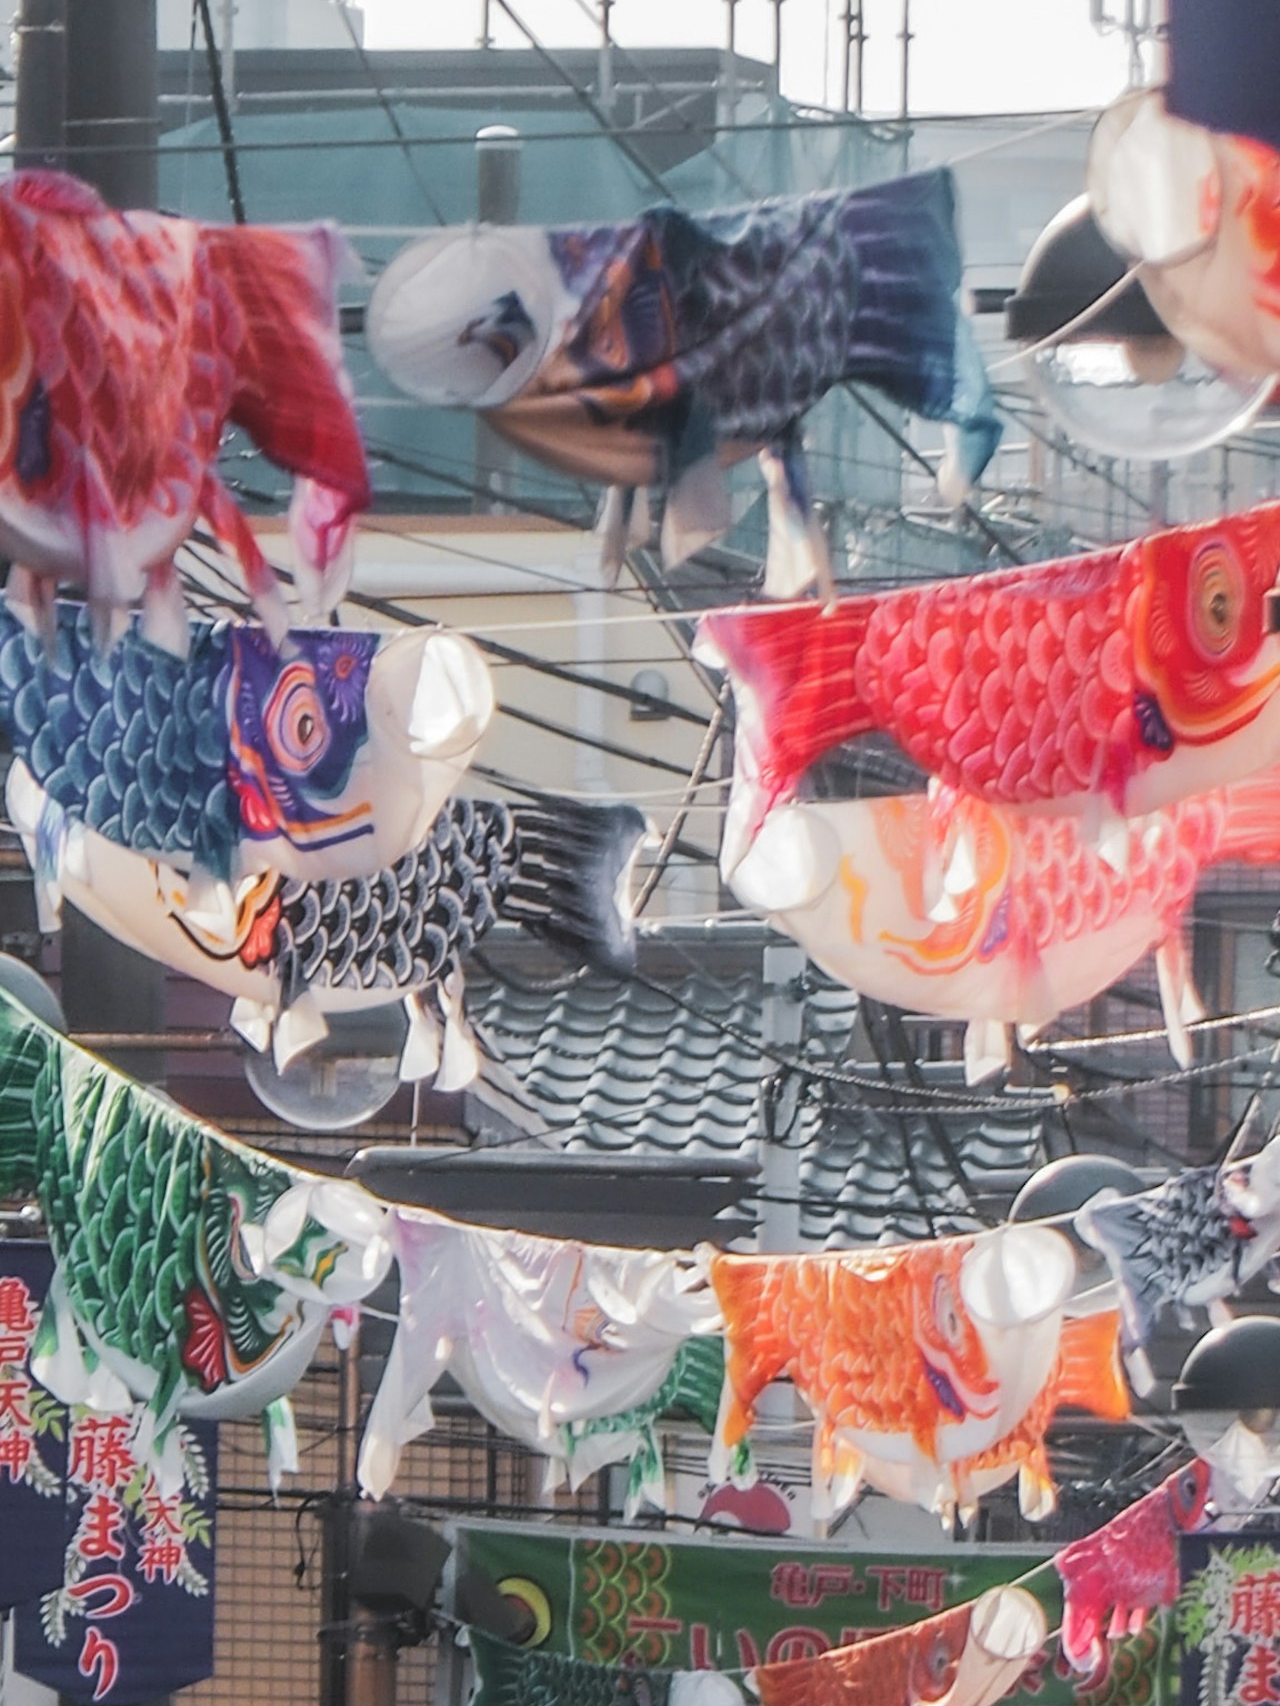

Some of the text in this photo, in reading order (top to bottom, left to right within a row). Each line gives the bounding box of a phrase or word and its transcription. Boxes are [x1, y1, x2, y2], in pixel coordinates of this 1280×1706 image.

[67, 1413, 136, 1701] 藤まつり
[135, 1473, 185, 1585] 天神
